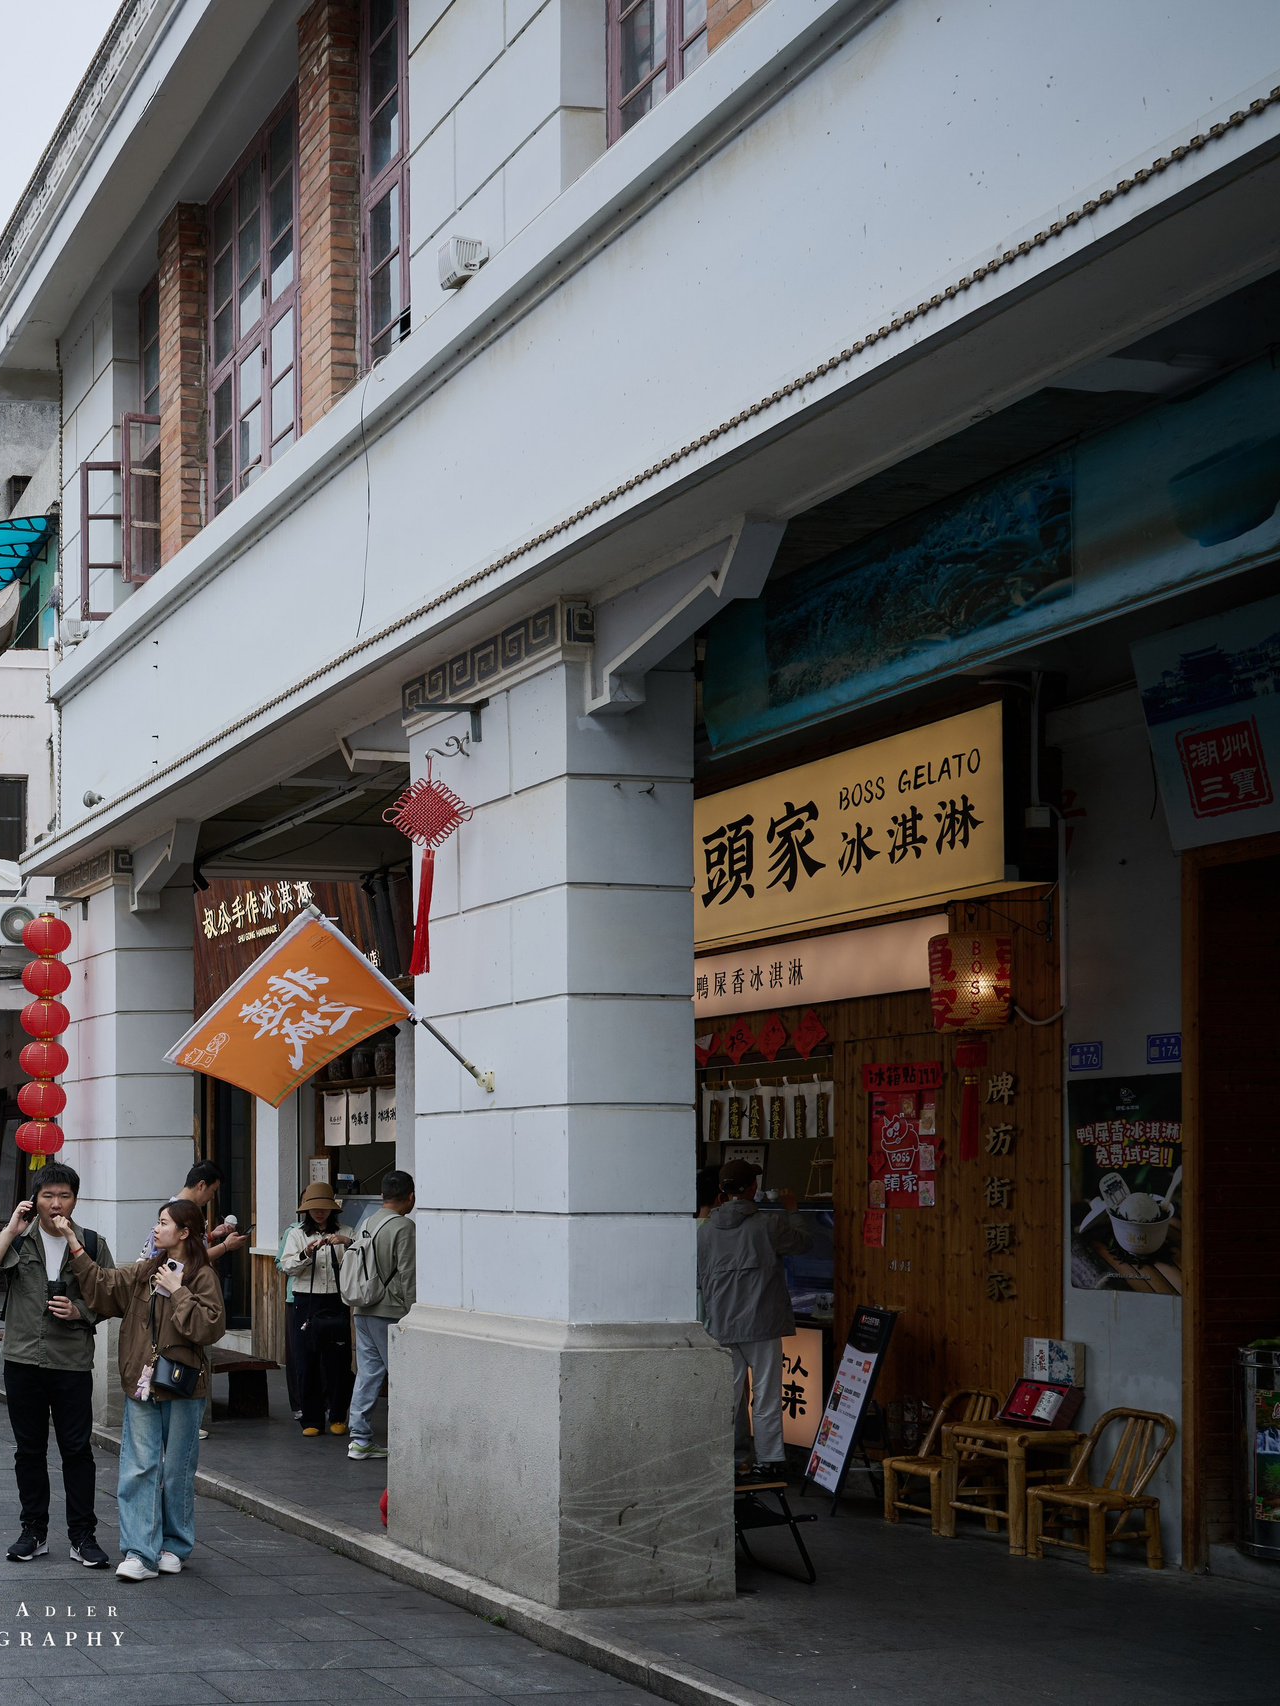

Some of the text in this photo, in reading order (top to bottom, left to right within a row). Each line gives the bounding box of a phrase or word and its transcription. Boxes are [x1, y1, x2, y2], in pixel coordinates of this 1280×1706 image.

[1190, 731, 1253, 767] 潮州
[839, 748, 981, 811] BOSS GELATO
[701, 800, 827, 908] 頭家
[838, 794, 985, 877] 冰淇淋
[695, 958, 804, 1000] 鴨屎香冰淇淋
[970, 941, 982, 1016] BOSS
[1080, 1054, 1098, 1065] 176
[1160, 1045, 1180, 1057] 174
[891, 1150, 911, 1164] BOSS
[884, 1172, 918, 1194] 頭家
[983, 1072, 1017, 1302] 牌坊街頭家
